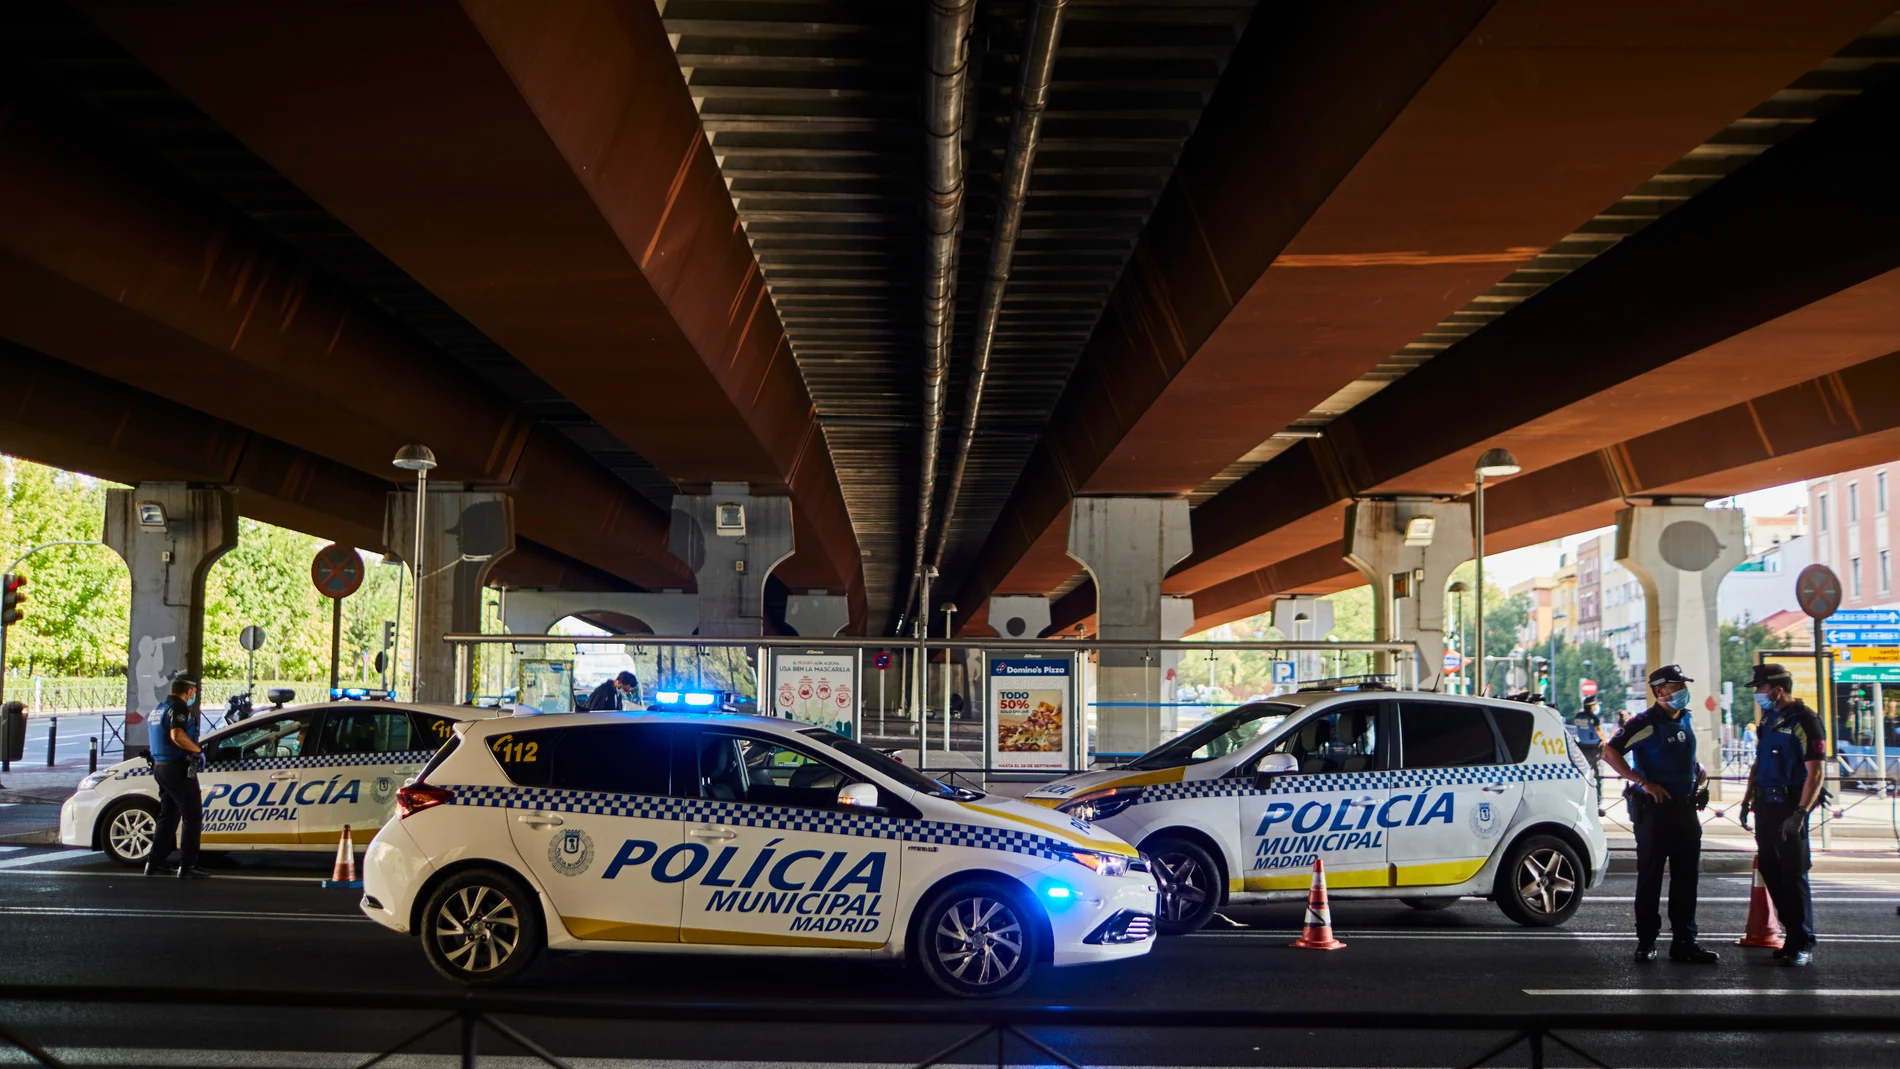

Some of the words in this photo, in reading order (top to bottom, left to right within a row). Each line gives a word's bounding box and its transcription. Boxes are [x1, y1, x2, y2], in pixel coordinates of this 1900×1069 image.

[1006, 666, 1042, 674] Domino's
[1043, 666, 1065, 674] Pizza
[1000, 699, 1029, 709] 50%
[439, 725, 451, 738] 11
[503, 742, 539, 762] 112
[1541, 738, 1566, 755] 112
[202, 774, 361, 808] POLICÍA
[201, 807, 298, 822] MUNICIPAL
[1255, 787, 1455, 836] POLICÍA
[200, 822, 247, 832] MADRID
[1256, 831, 1383, 857] MUNICIPAL
[601, 838, 887, 894] POLÍCIA
[1254, 854, 1319, 870] MADRID
[705, 890, 881, 916] MUNICIPAL
[789, 916, 879, 933] MADRID
